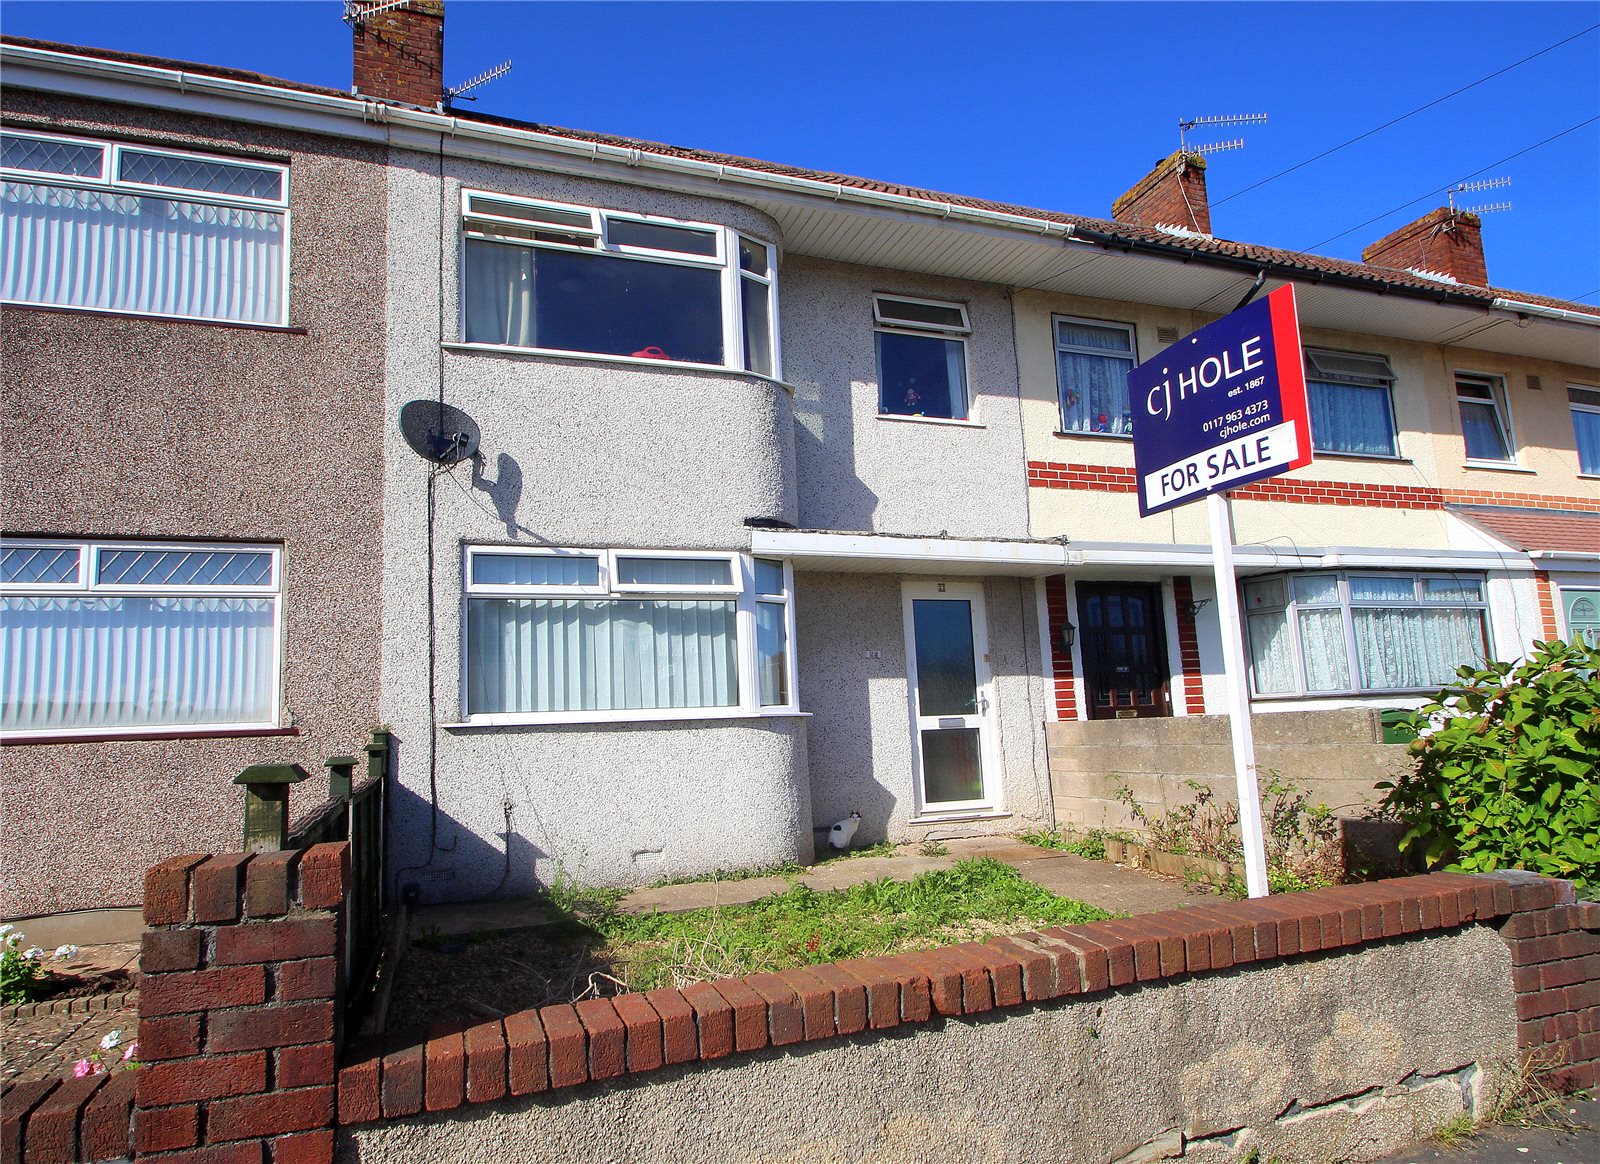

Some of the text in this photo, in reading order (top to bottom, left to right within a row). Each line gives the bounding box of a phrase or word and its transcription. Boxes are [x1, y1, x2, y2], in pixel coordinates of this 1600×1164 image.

[1178, 335, 1264, 400] HOLE
[1227, 376, 1265, 398] est. 1867
[1202, 399, 1269, 433] 0117 963 4373
[1219, 413, 1271, 439] cjhole.com
[1160, 435, 1272, 497] FOR SALE
